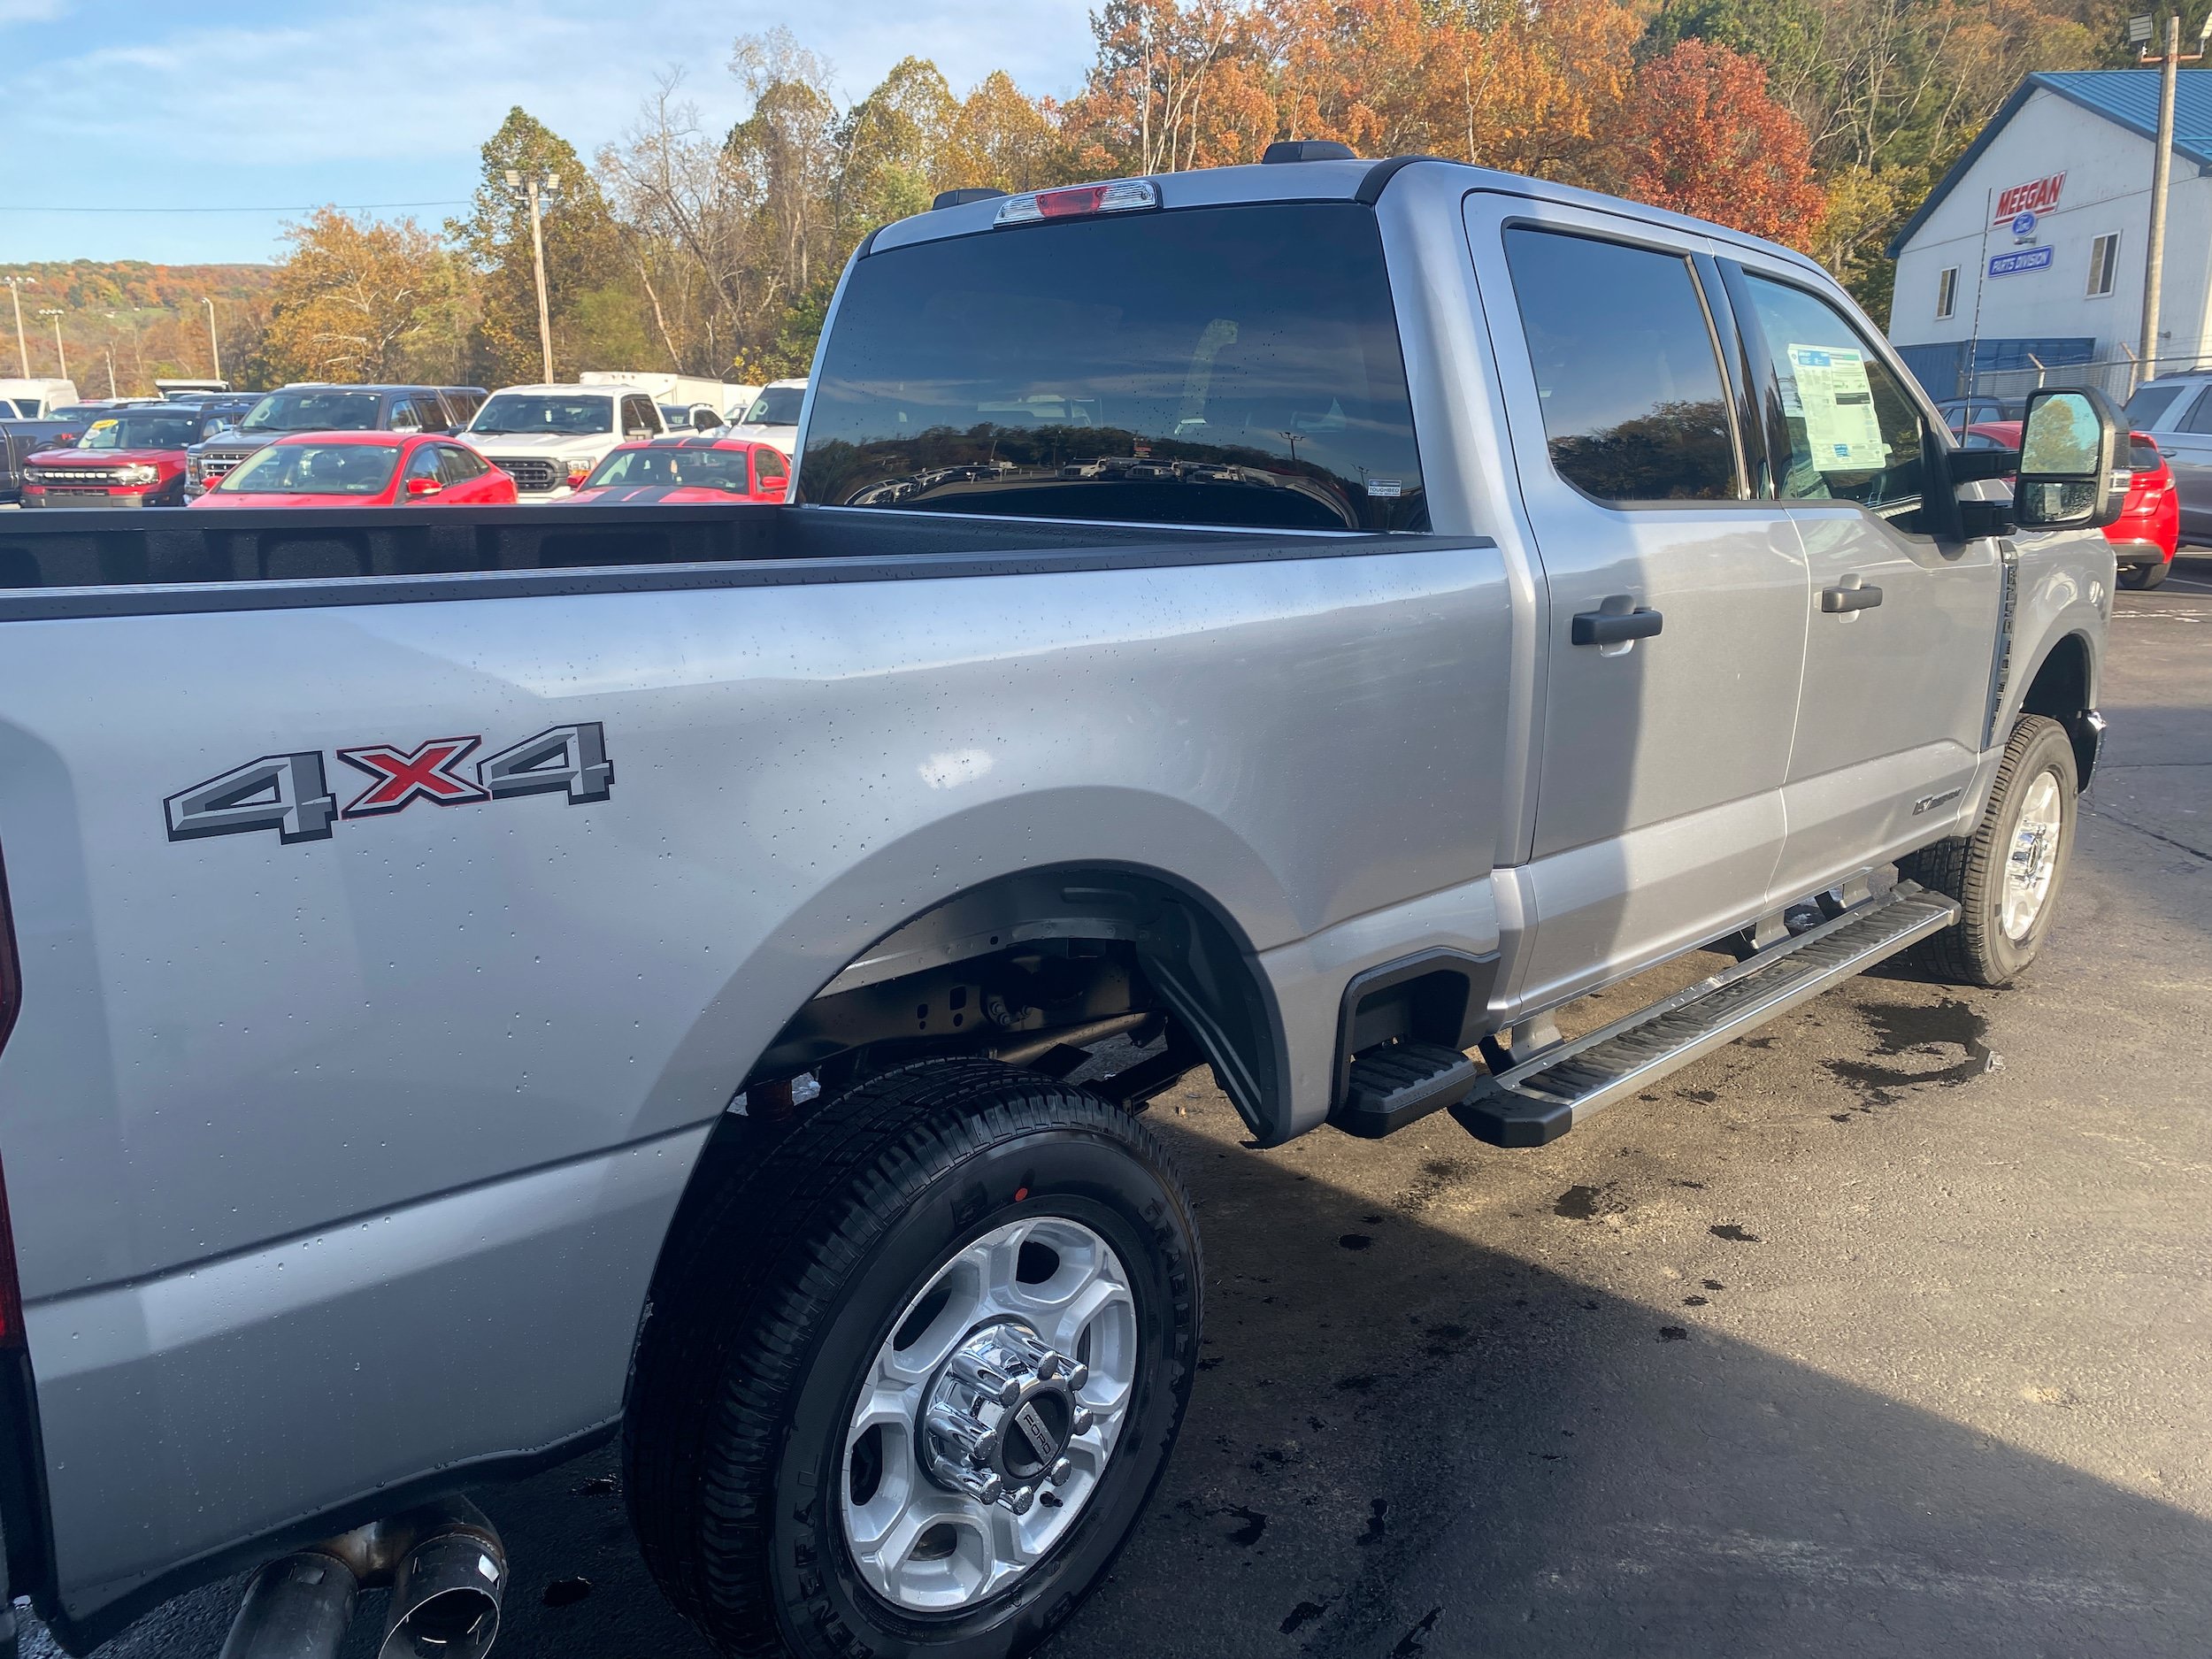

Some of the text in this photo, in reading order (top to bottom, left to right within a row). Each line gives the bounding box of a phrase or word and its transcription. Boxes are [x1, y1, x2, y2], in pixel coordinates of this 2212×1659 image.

[1995, 173, 2064, 219] MEEGAN
[1991, 250, 2050, 273] PARTS DIVISION
[163, 720, 615, 846] 4X4
[1023, 1413, 1052, 1456] FORD
